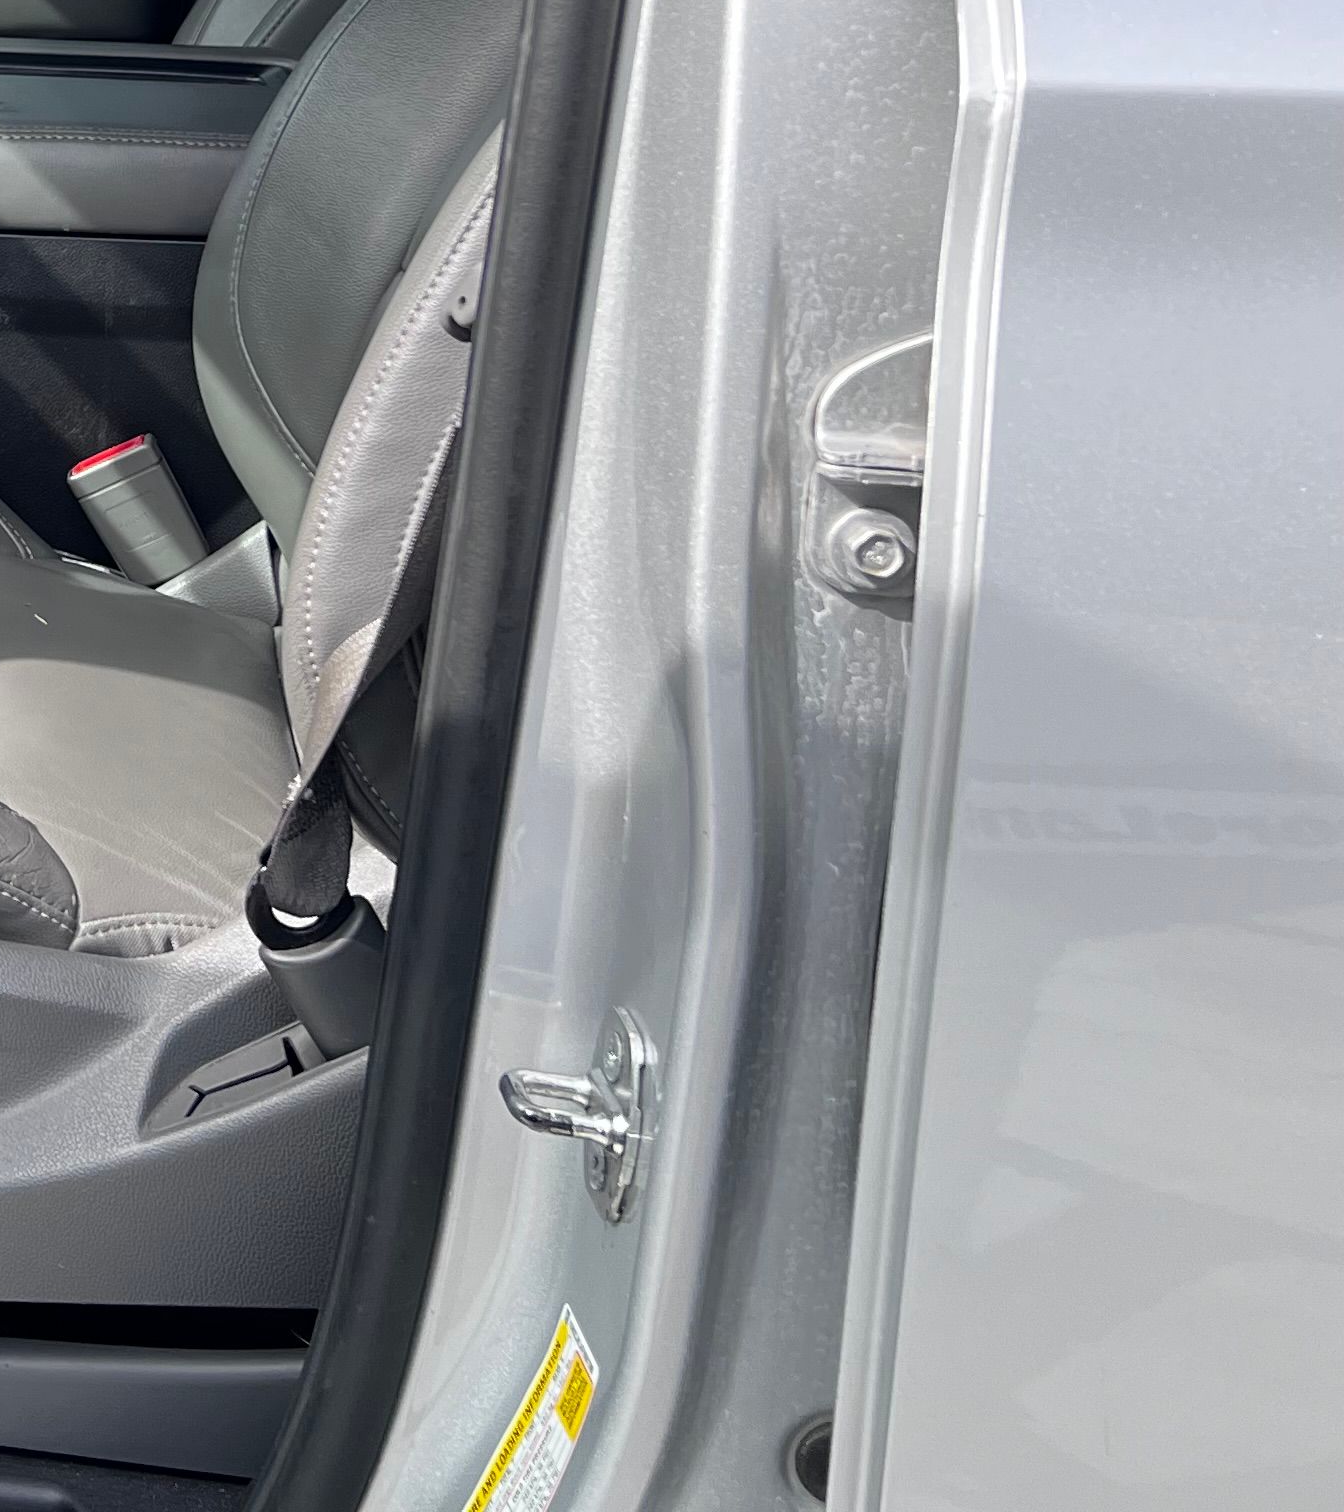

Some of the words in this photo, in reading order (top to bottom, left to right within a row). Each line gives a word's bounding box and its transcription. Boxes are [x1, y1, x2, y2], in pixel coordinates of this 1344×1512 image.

[480, 1471, 498, 1498] AND
[495, 1419, 526, 1472] LOADING
[522, 1339, 563, 1422] INFORMATION
